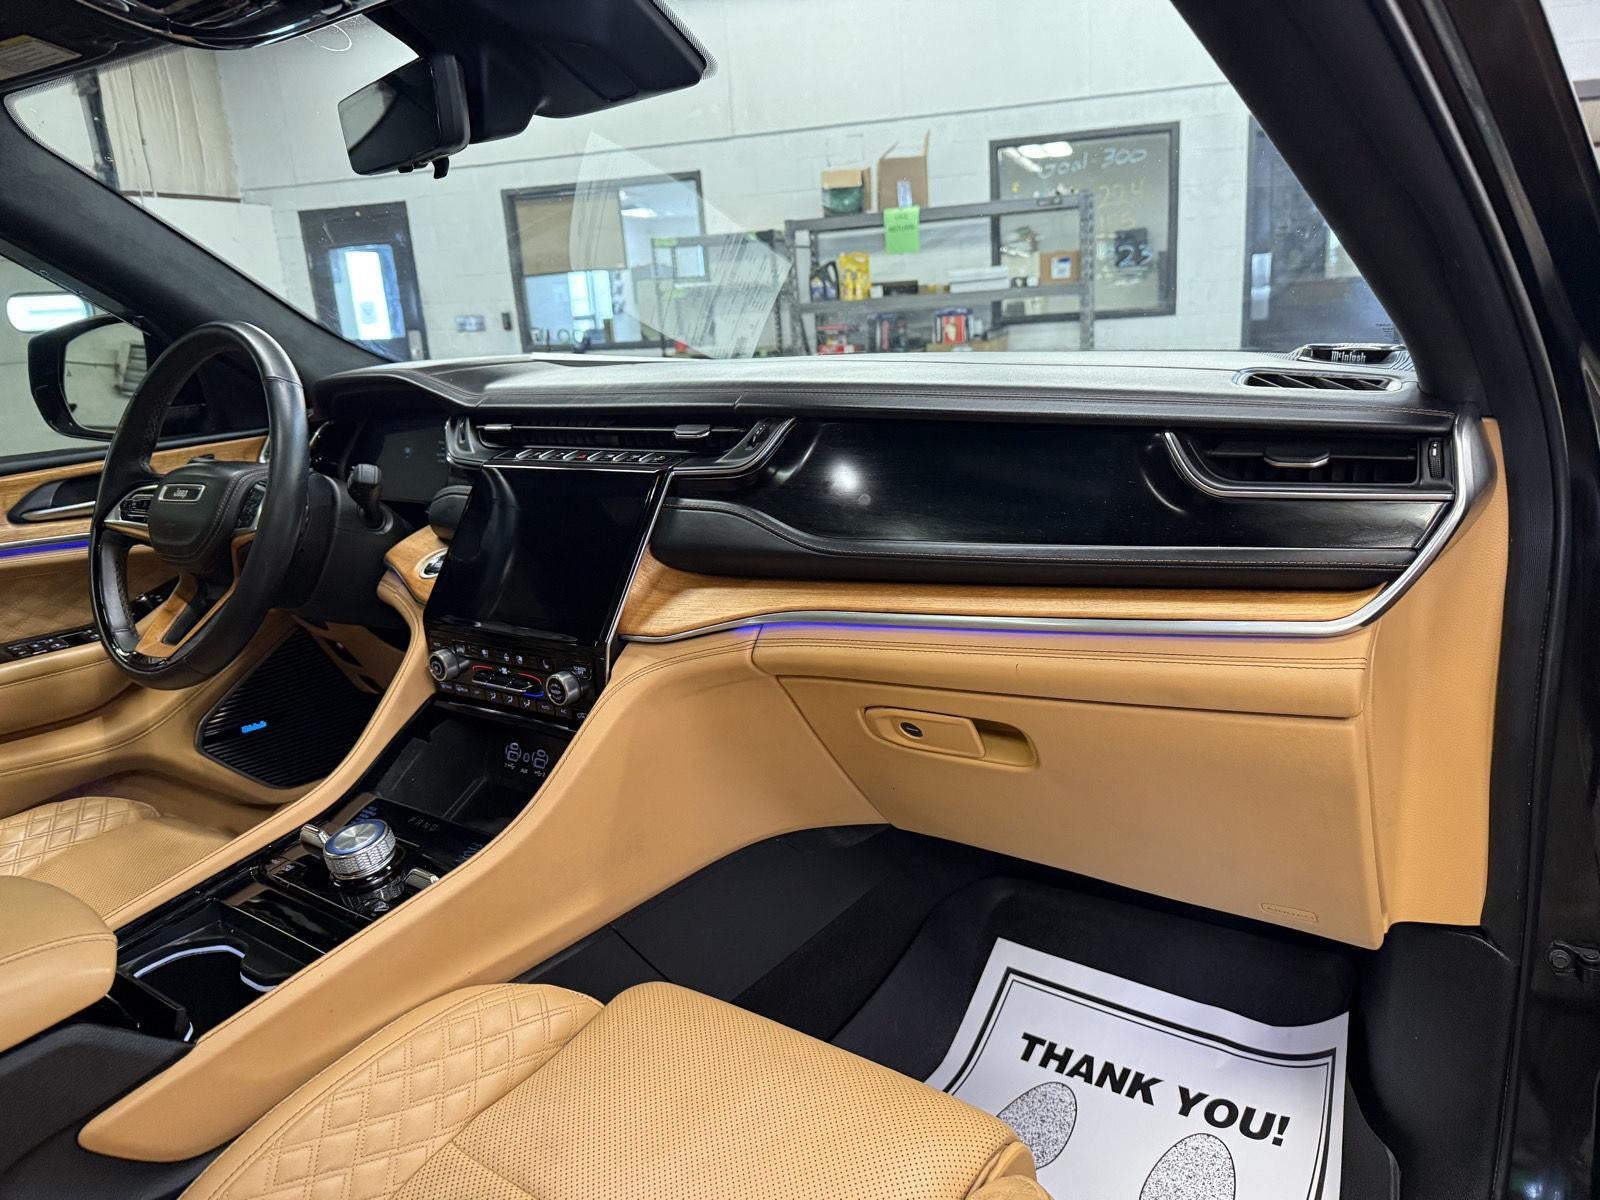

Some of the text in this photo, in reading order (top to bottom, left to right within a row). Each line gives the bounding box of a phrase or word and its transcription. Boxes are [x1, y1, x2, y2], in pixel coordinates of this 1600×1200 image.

[1101, 147, 1147, 169] 300
[173, 487, 189, 499] Jeep
[1020, 1031, 1291, 1147] THANK YOU!
